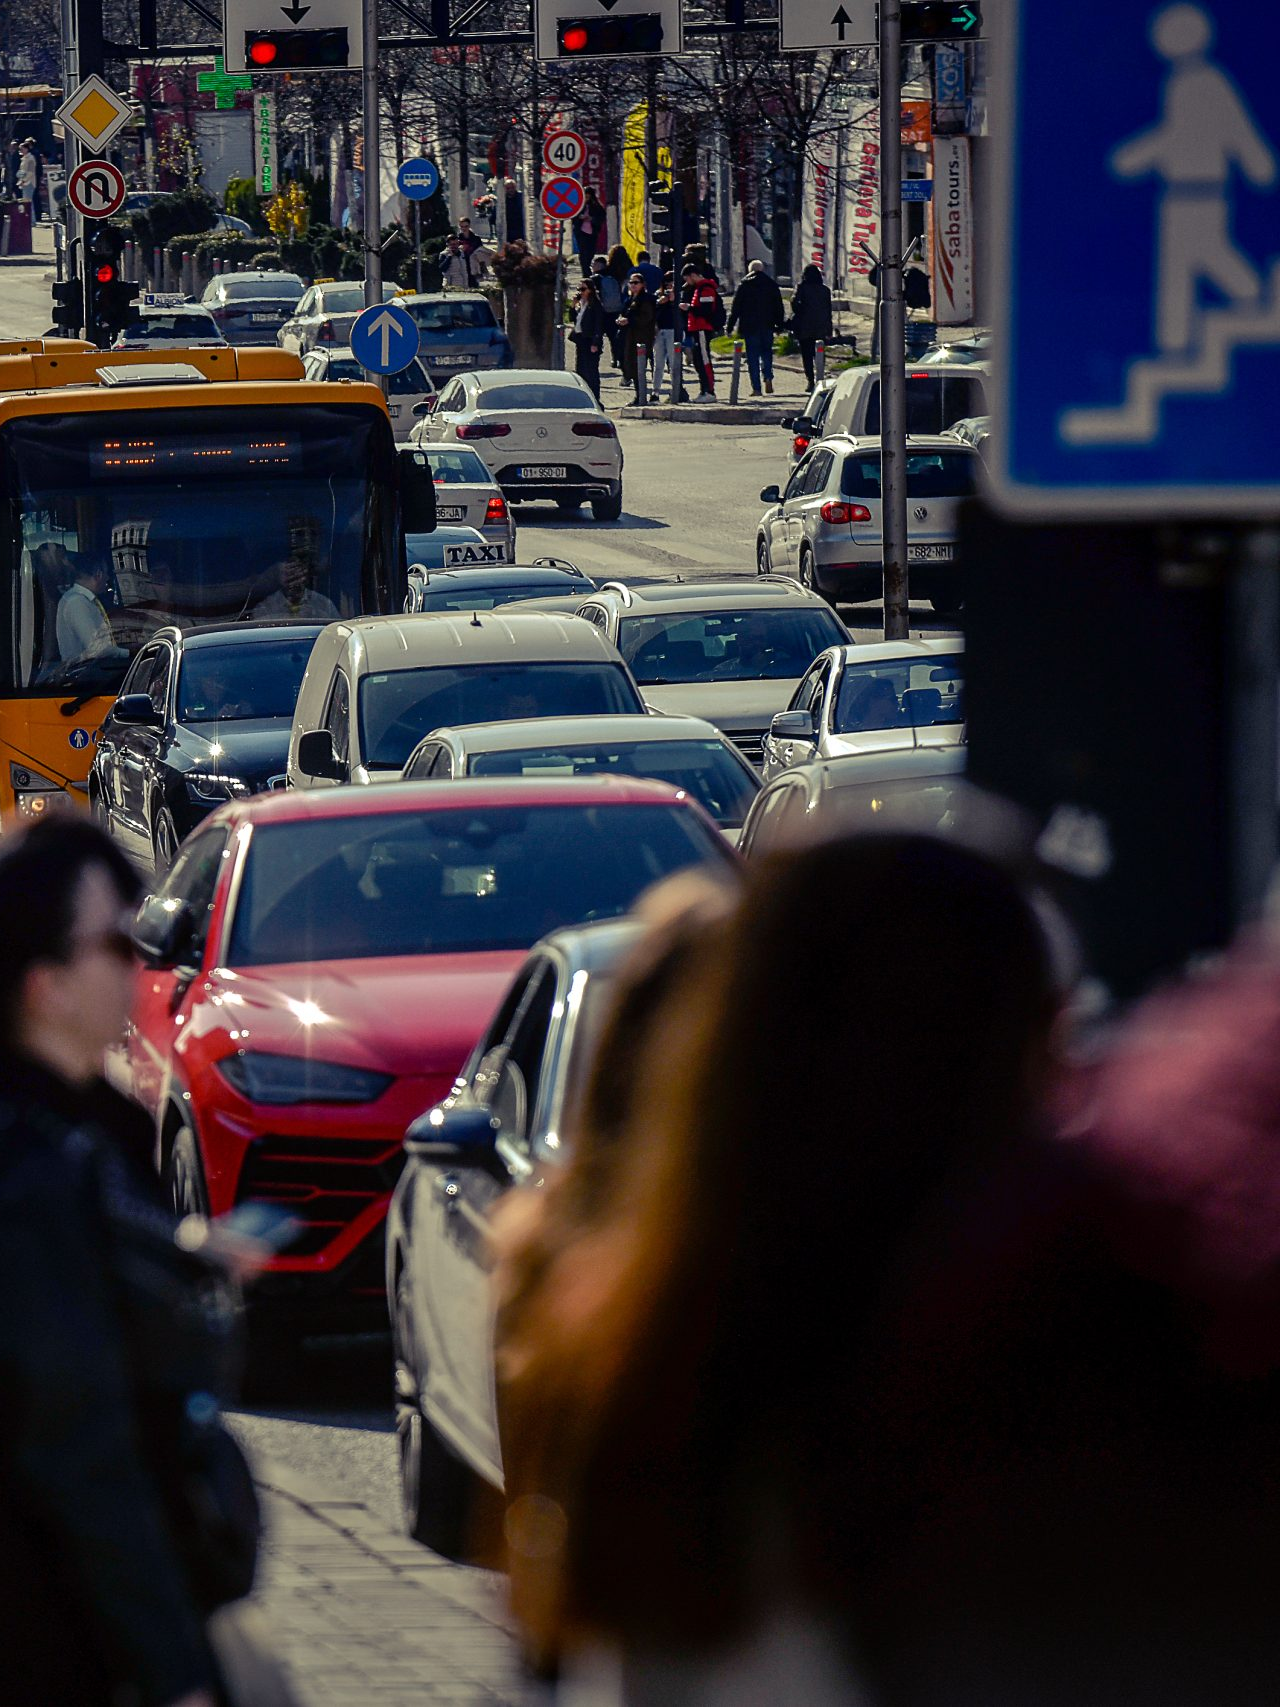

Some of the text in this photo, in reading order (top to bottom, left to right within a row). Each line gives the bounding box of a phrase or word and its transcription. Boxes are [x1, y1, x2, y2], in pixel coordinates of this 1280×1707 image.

[260, 108, 272, 193] BARNATORE
[554, 142, 576, 162] 40
[447, 544, 506, 563] TAXI
